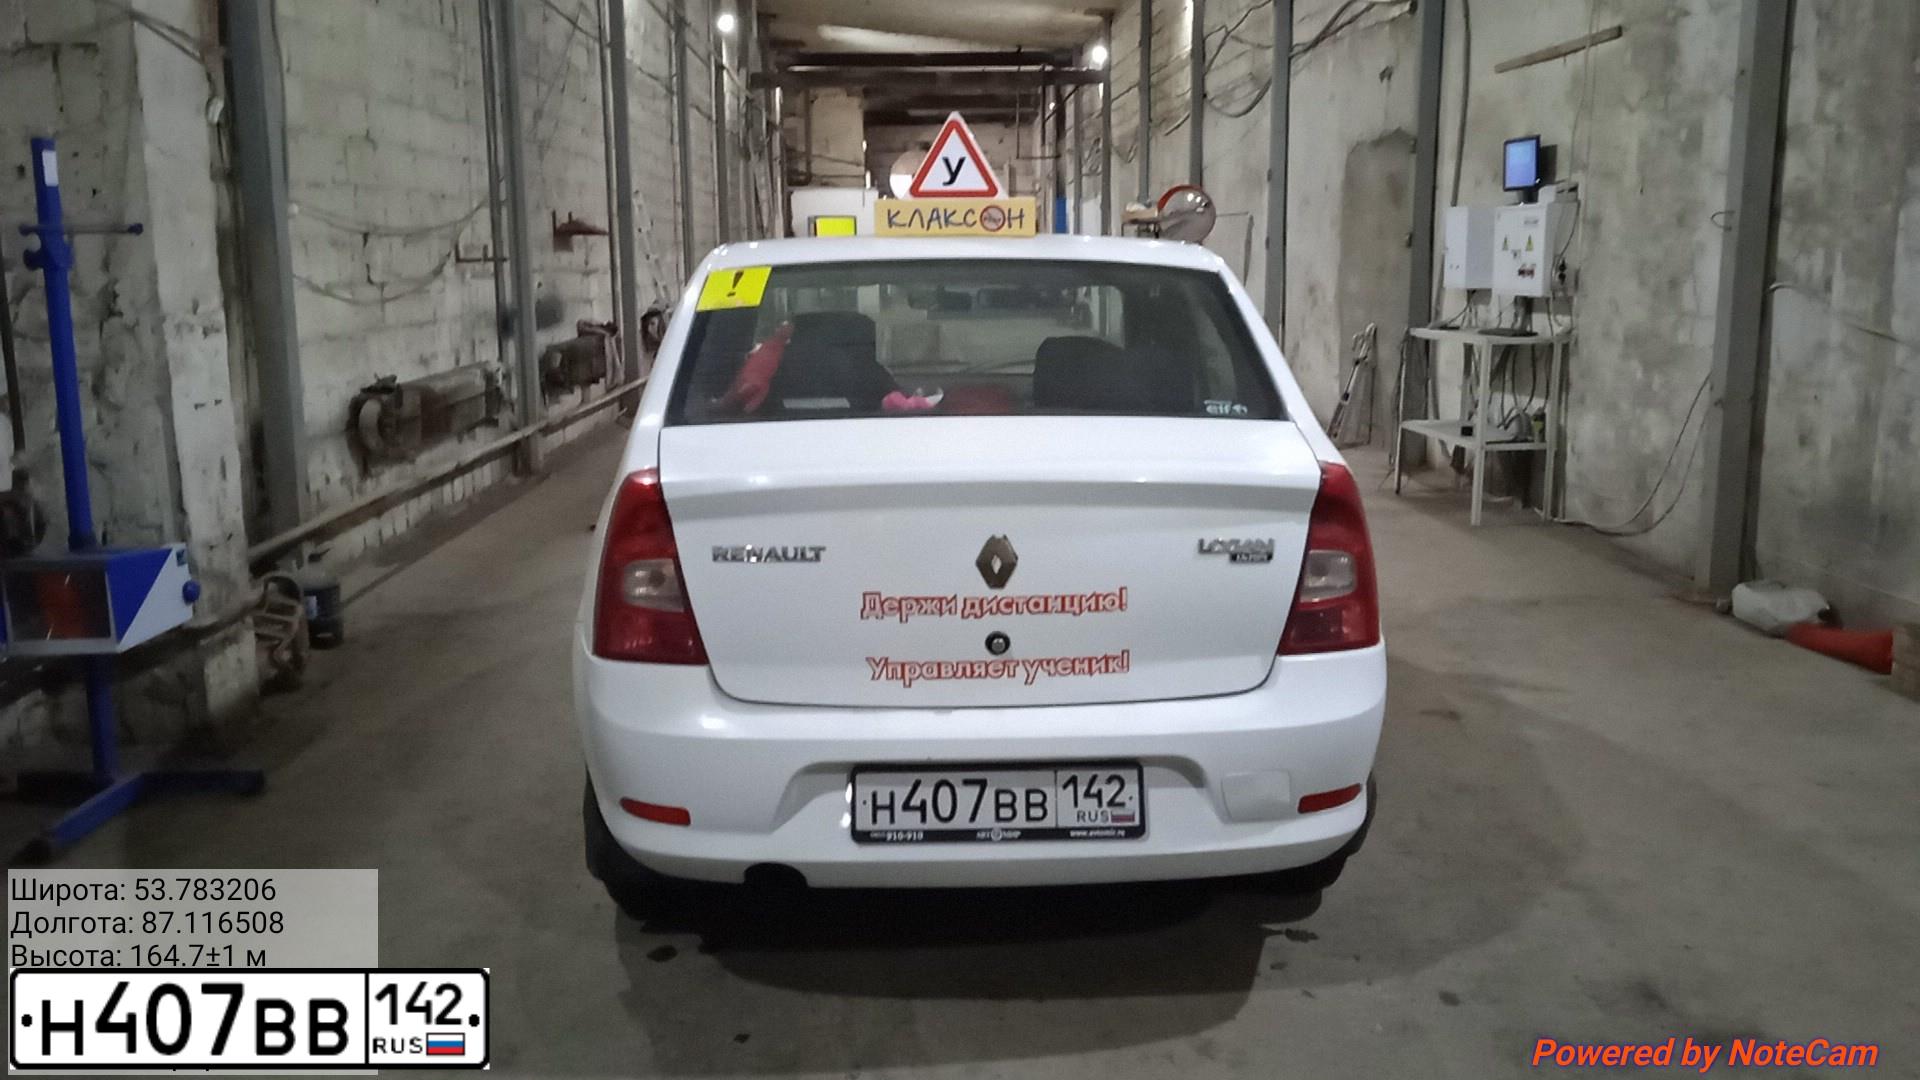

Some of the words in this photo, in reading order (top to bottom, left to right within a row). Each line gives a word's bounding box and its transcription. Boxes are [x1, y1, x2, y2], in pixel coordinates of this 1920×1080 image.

[942, 156, 967, 186] У
[712, 546, 826, 563] RENAULT
[861, 592, 957, 623] Держи
[961, 587, 1127, 619] дистанцию!
[866, 656, 1019, 688] Управляет
[1022, 650, 1130, 685] ученик!
[871, 778, 1048, 825] Н407ВВ
[1062, 774, 1126, 809] 142
[1077, 810, 1109, 823] RUS
